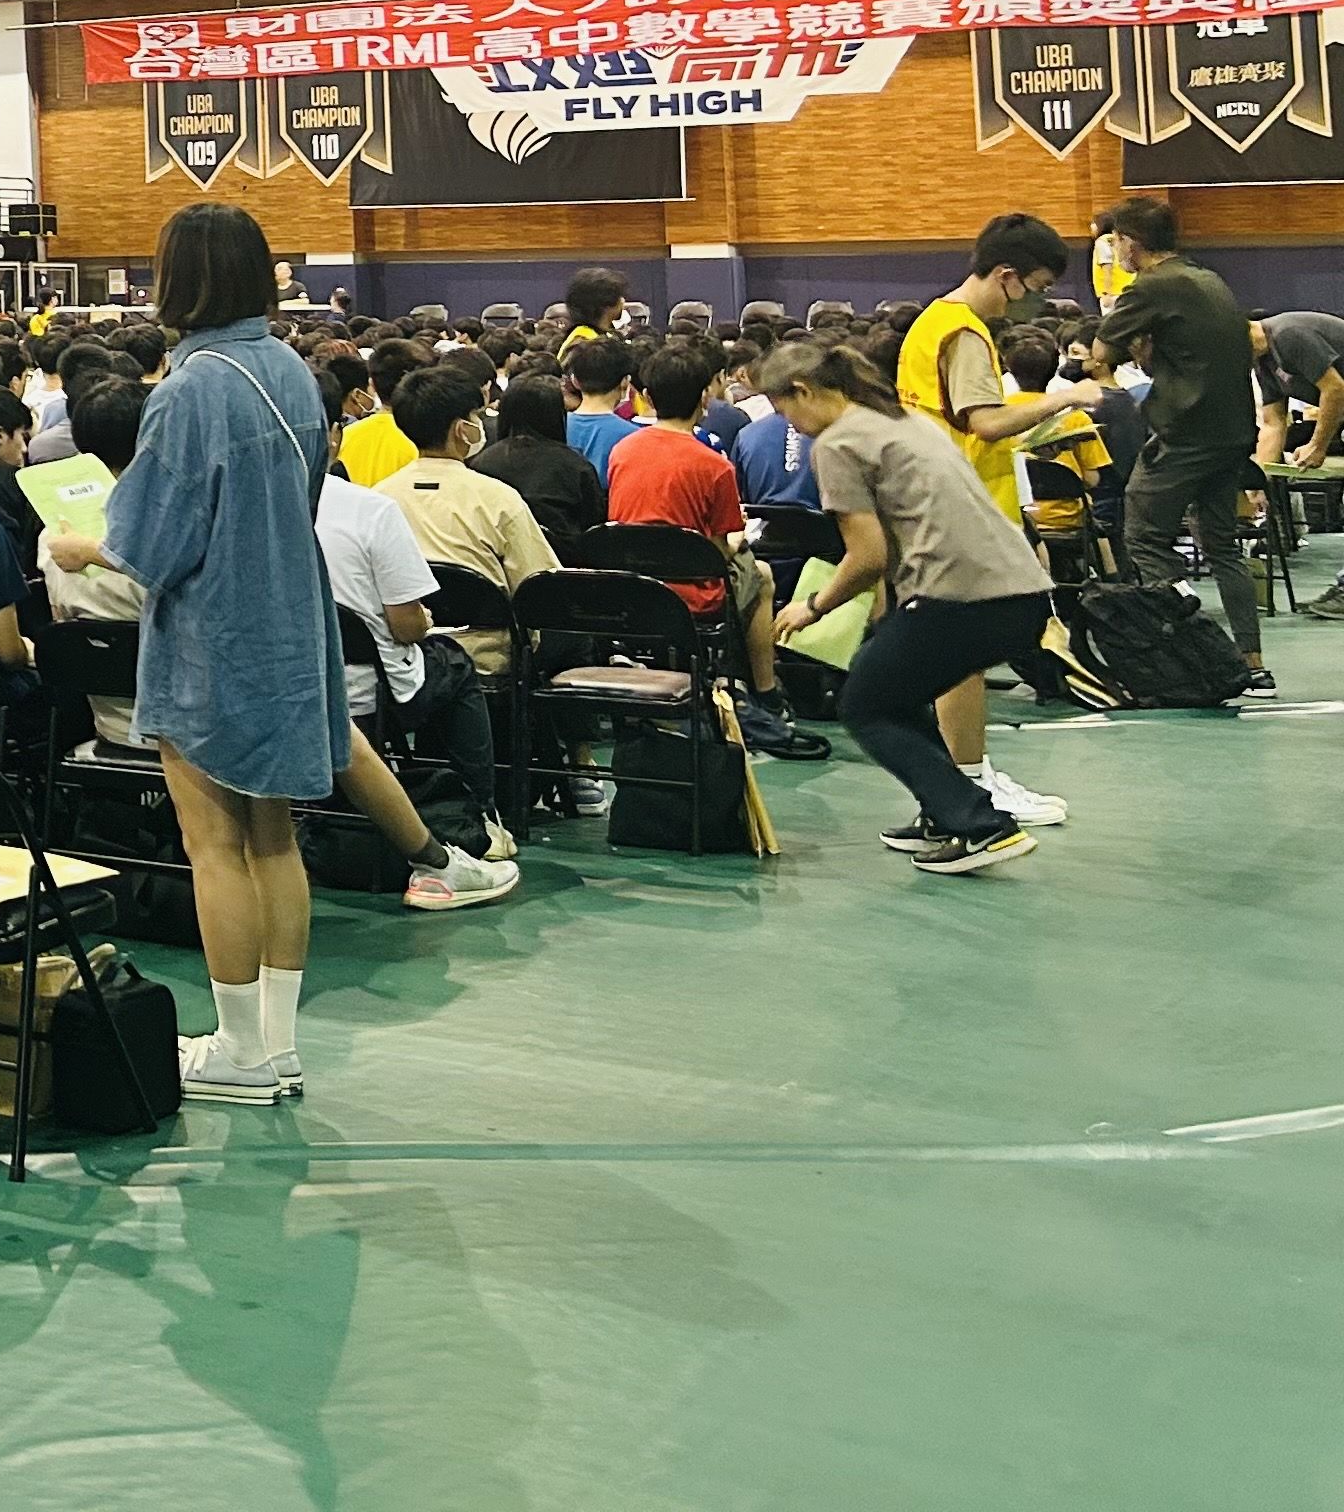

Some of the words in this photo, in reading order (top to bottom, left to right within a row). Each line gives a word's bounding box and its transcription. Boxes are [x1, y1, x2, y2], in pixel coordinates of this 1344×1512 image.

[1035, 44, 1073, 68] UBA
[1010, 67, 1103, 95] CHAMPION
[186, 94, 213, 114] UBA
[310, 86, 339, 106] UBA
[564, 95, 642, 122] FLY
[650, 88, 763, 118] HIGH
[292, 106, 361, 129] CHAMPION
[1042, 100, 1073, 131] 111
[1216, 101, 1261, 119] NCCU
[169, 114, 234, 136] CHAMPION
[186, 140, 217, 166] 109
[311, 133, 340, 160] 110
[784, 423, 800, 472] SWISS
